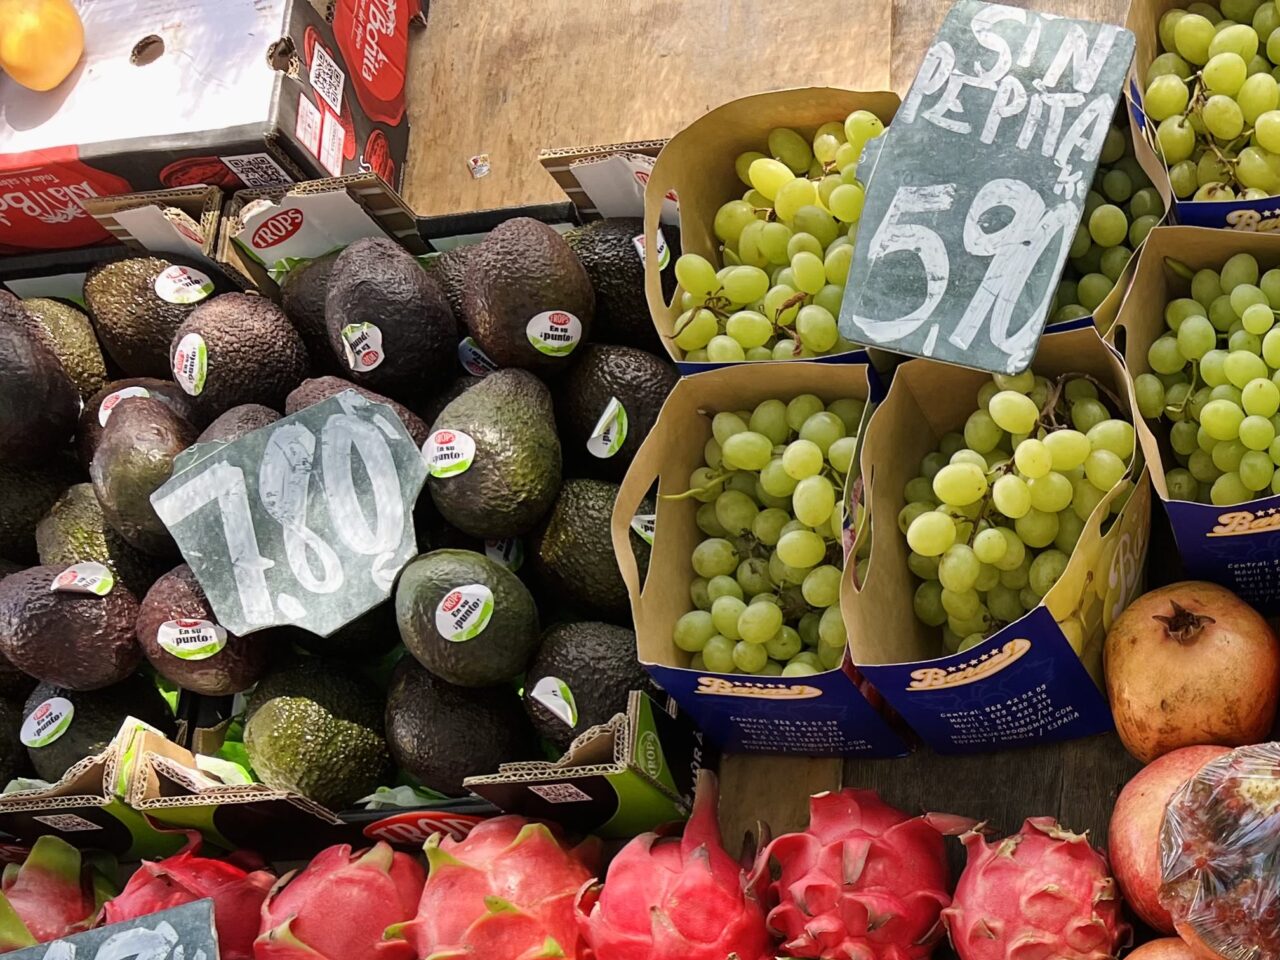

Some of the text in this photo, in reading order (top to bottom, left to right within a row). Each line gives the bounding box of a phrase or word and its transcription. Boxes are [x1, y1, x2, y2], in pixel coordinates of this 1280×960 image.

[955, 1, 1121, 94] SIN
[900, 41, 1116, 166] PEPITA
[253, 209, 302, 248] TROPS
